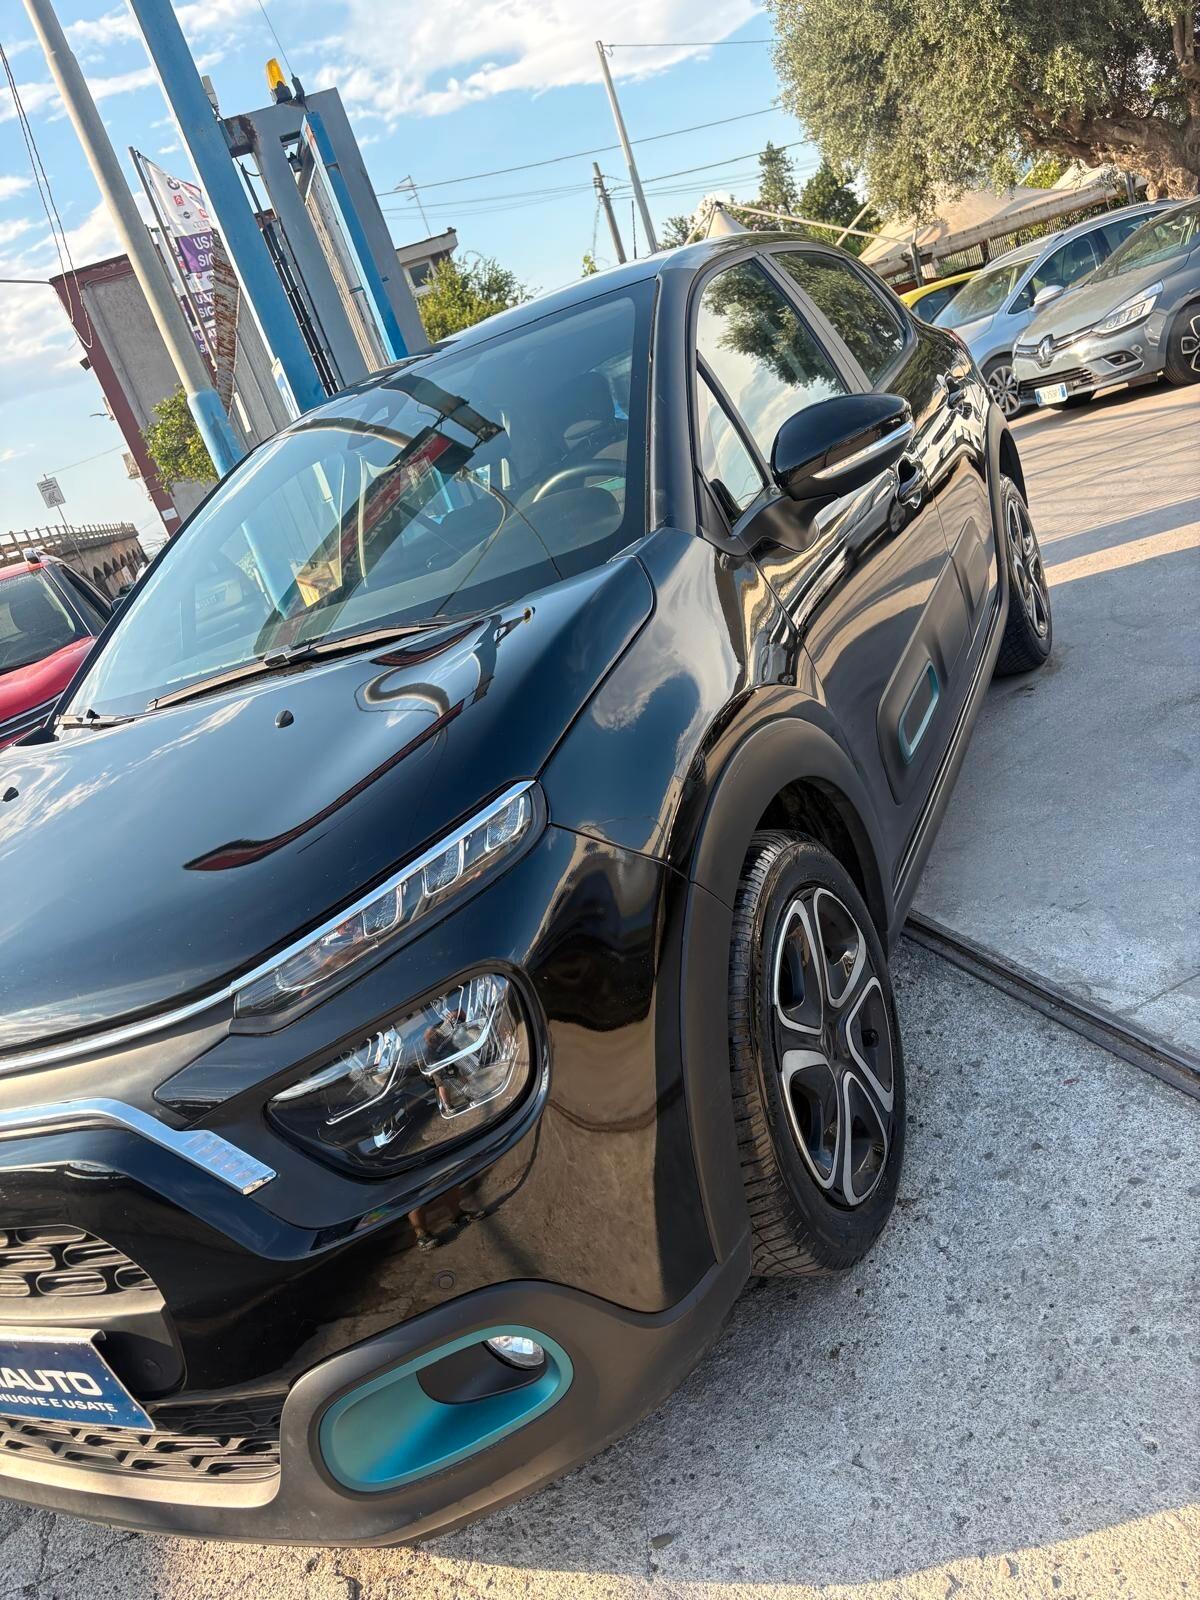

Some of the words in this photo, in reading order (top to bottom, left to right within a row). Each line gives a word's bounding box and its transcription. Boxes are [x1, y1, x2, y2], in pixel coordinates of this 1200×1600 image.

[0, 1393, 49, 1406] NUOVE
[50, 1398, 63, 1408] E
[64, 1400, 118, 1413] USATE
